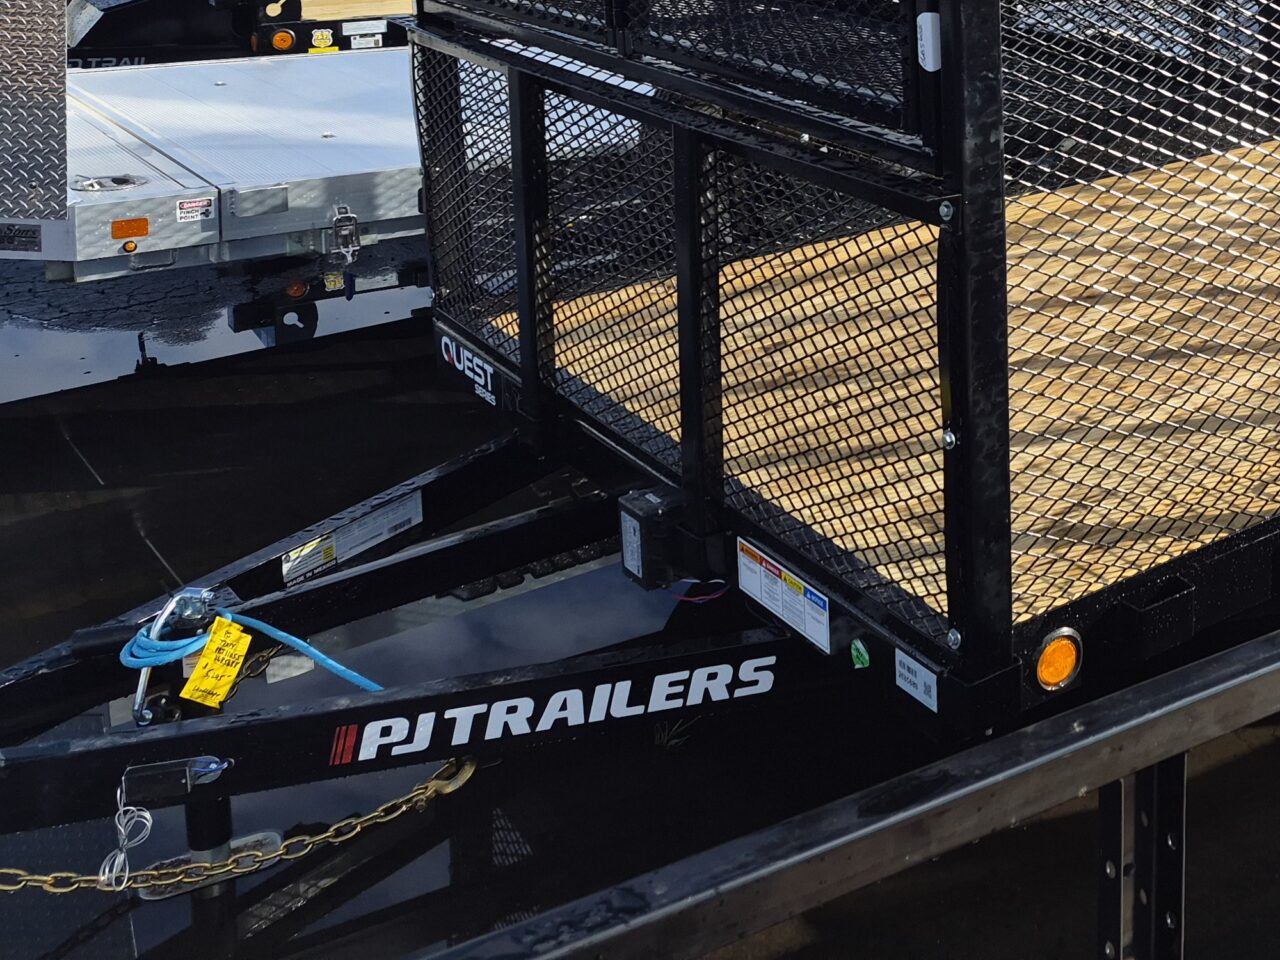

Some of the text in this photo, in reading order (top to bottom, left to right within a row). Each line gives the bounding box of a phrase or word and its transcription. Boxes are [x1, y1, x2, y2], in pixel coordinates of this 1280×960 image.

[441, 335, 494, 392] QUEST
[474, 383, 497, 406] SERIES
[443, 655, 777, 746] TRAILERS
